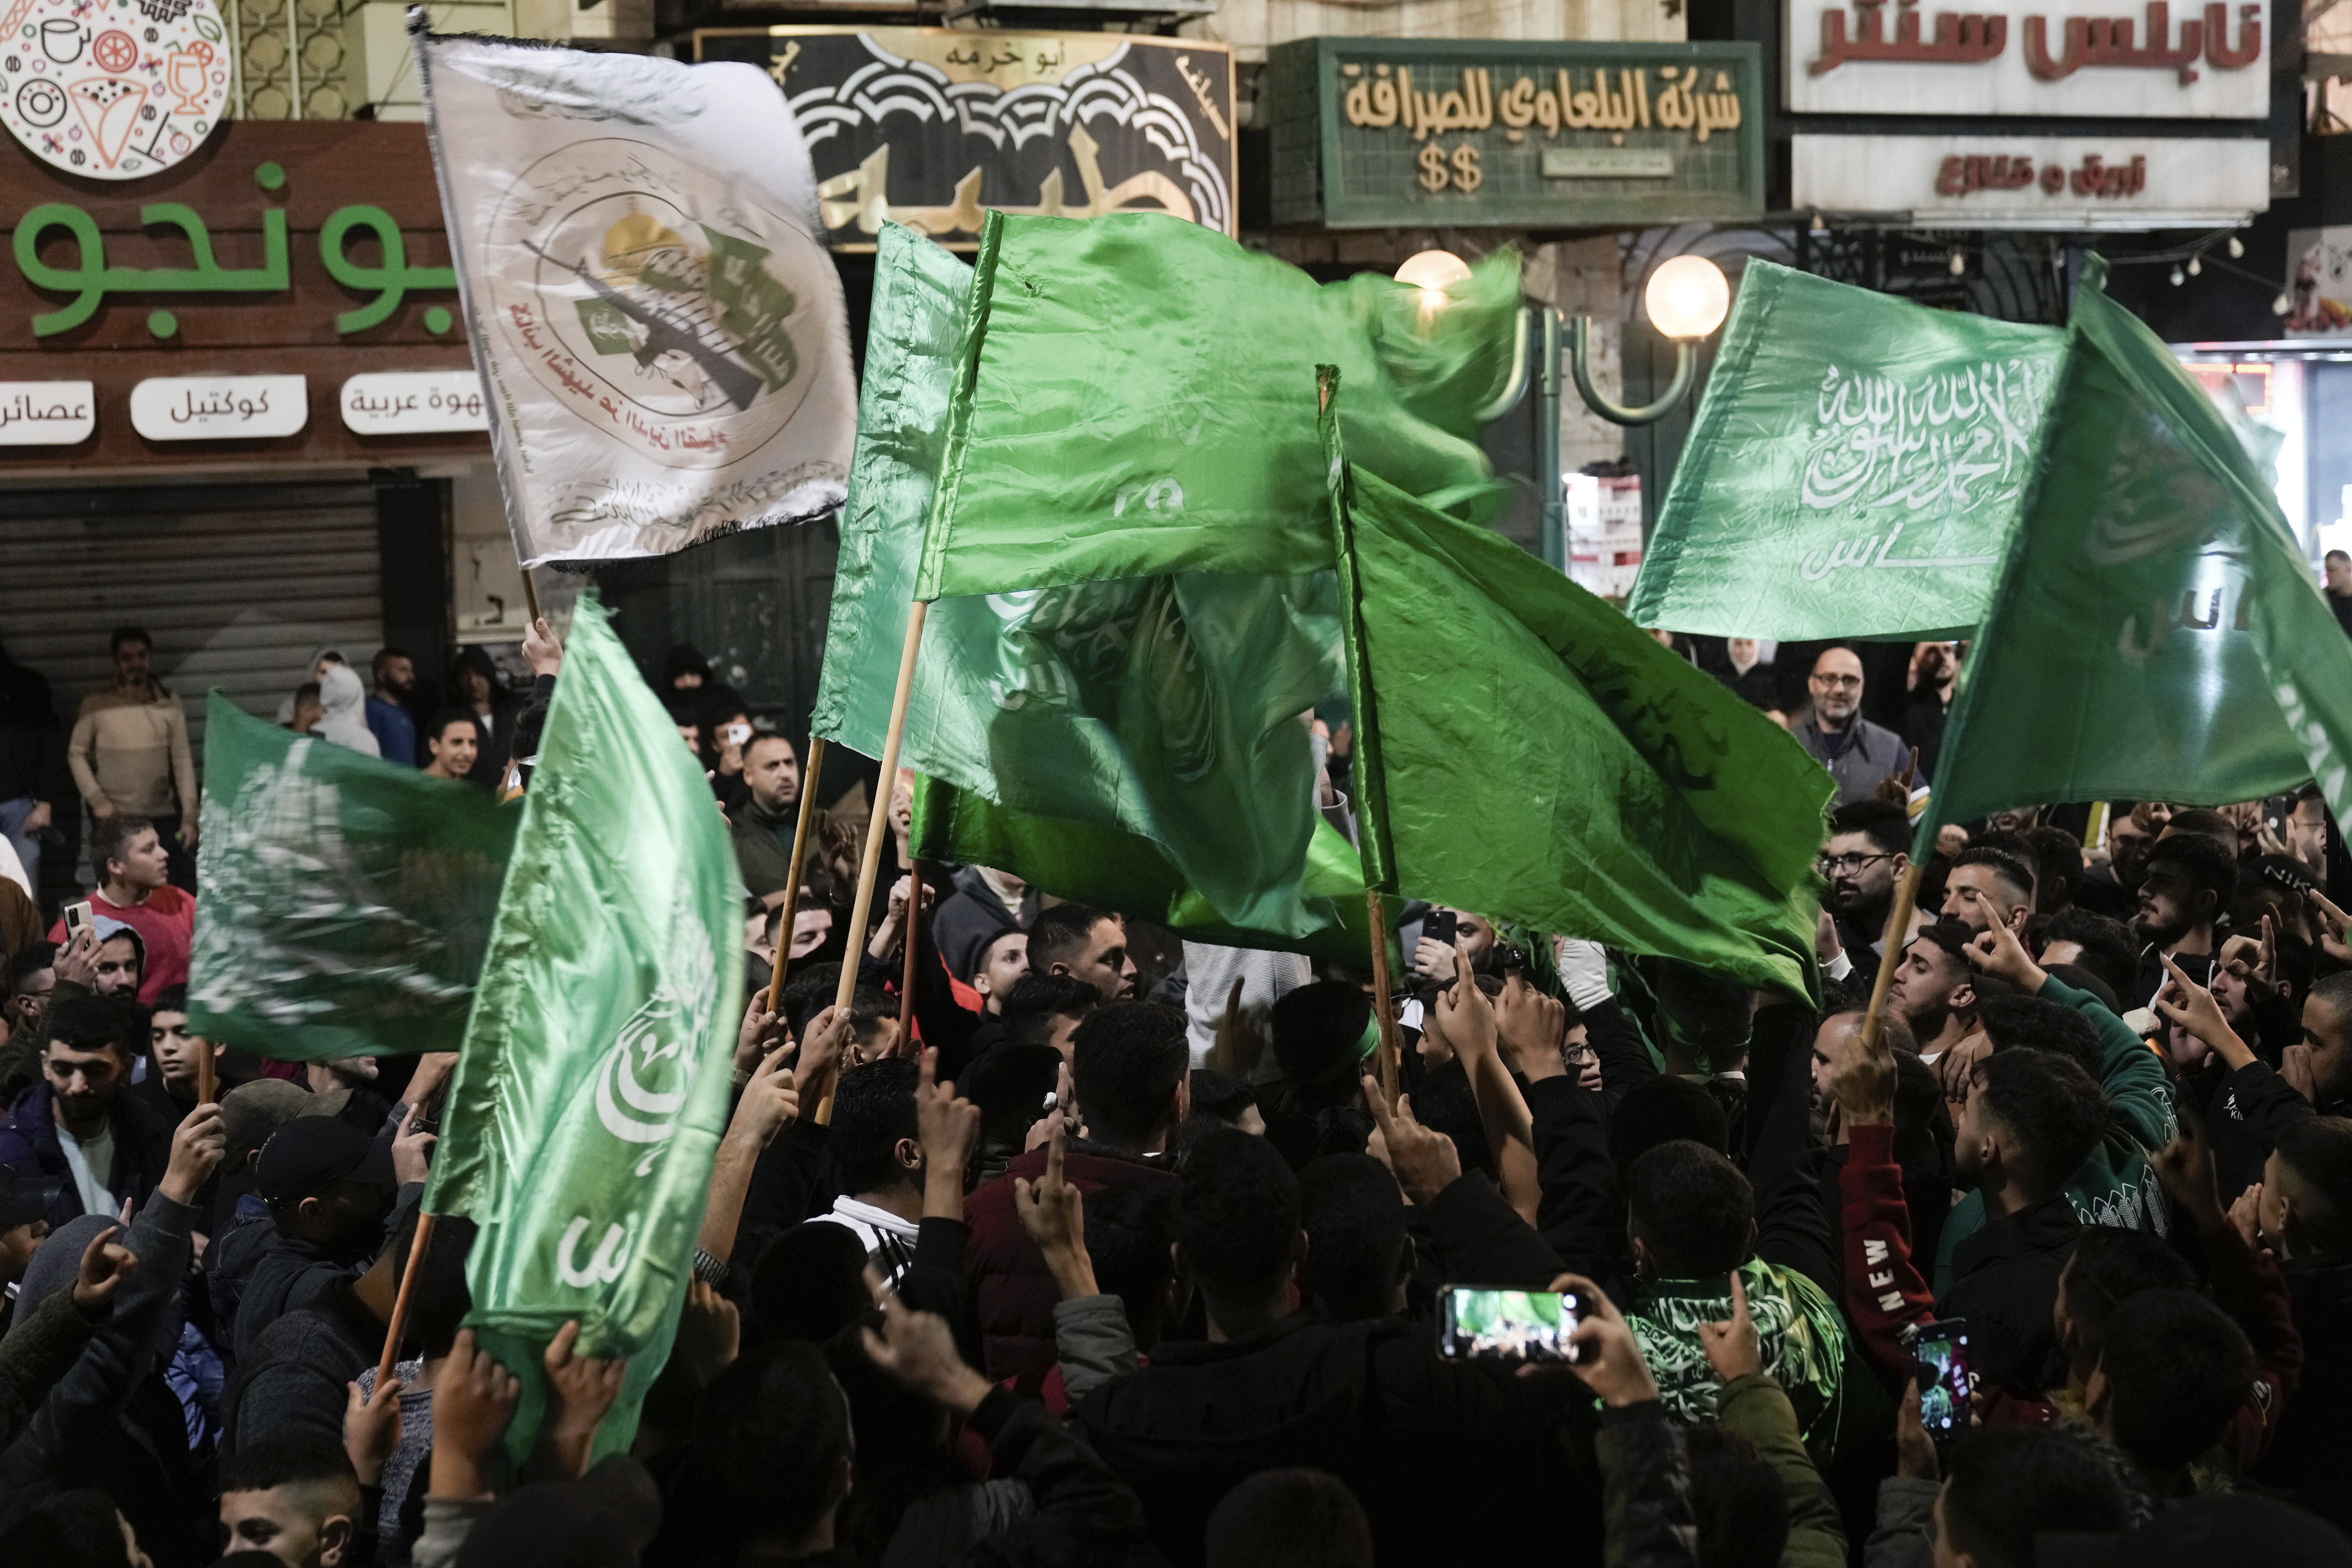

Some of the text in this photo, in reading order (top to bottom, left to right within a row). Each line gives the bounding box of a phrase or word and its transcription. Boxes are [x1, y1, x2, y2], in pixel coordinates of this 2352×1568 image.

[2022, 0, 2262, 87] نابلس
[1344, 64, 1741, 146] شركة البلعاوي للصرافة
[170, 389, 269, 423] كوكتيل
[351, 386, 486, 418] هوة عربية
[2264, 864, 2312, 897] NIK
[1863, 1239, 1906, 1312] NEW
